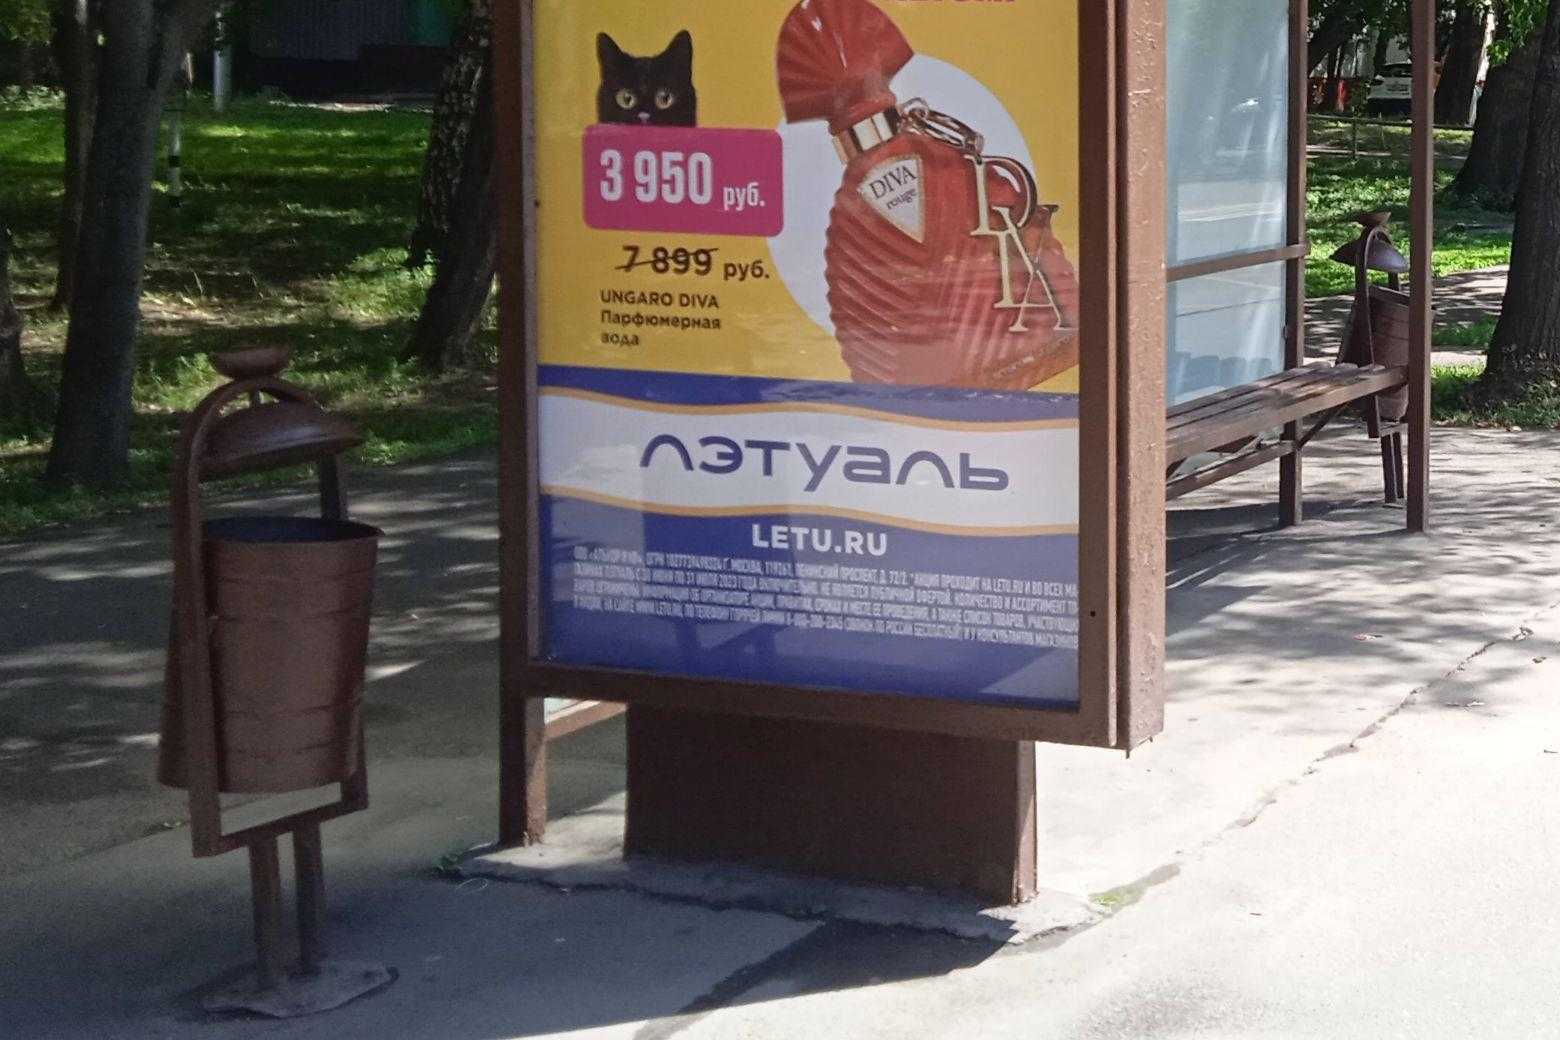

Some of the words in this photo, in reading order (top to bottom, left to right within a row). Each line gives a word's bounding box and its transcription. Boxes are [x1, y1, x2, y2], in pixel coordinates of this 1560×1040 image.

[869, 166, 918, 200] DIVA
[723, 182, 766, 211] руб.
[723, 260, 770, 282] руб.
[600, 289, 673, 307] UNGARO
[679, 293, 719, 309] DIVA
[601, 310, 721, 331] Парфюмерная
[601, 332, 640, 347] вода
[751, 523, 888, 558] LETU.RU
